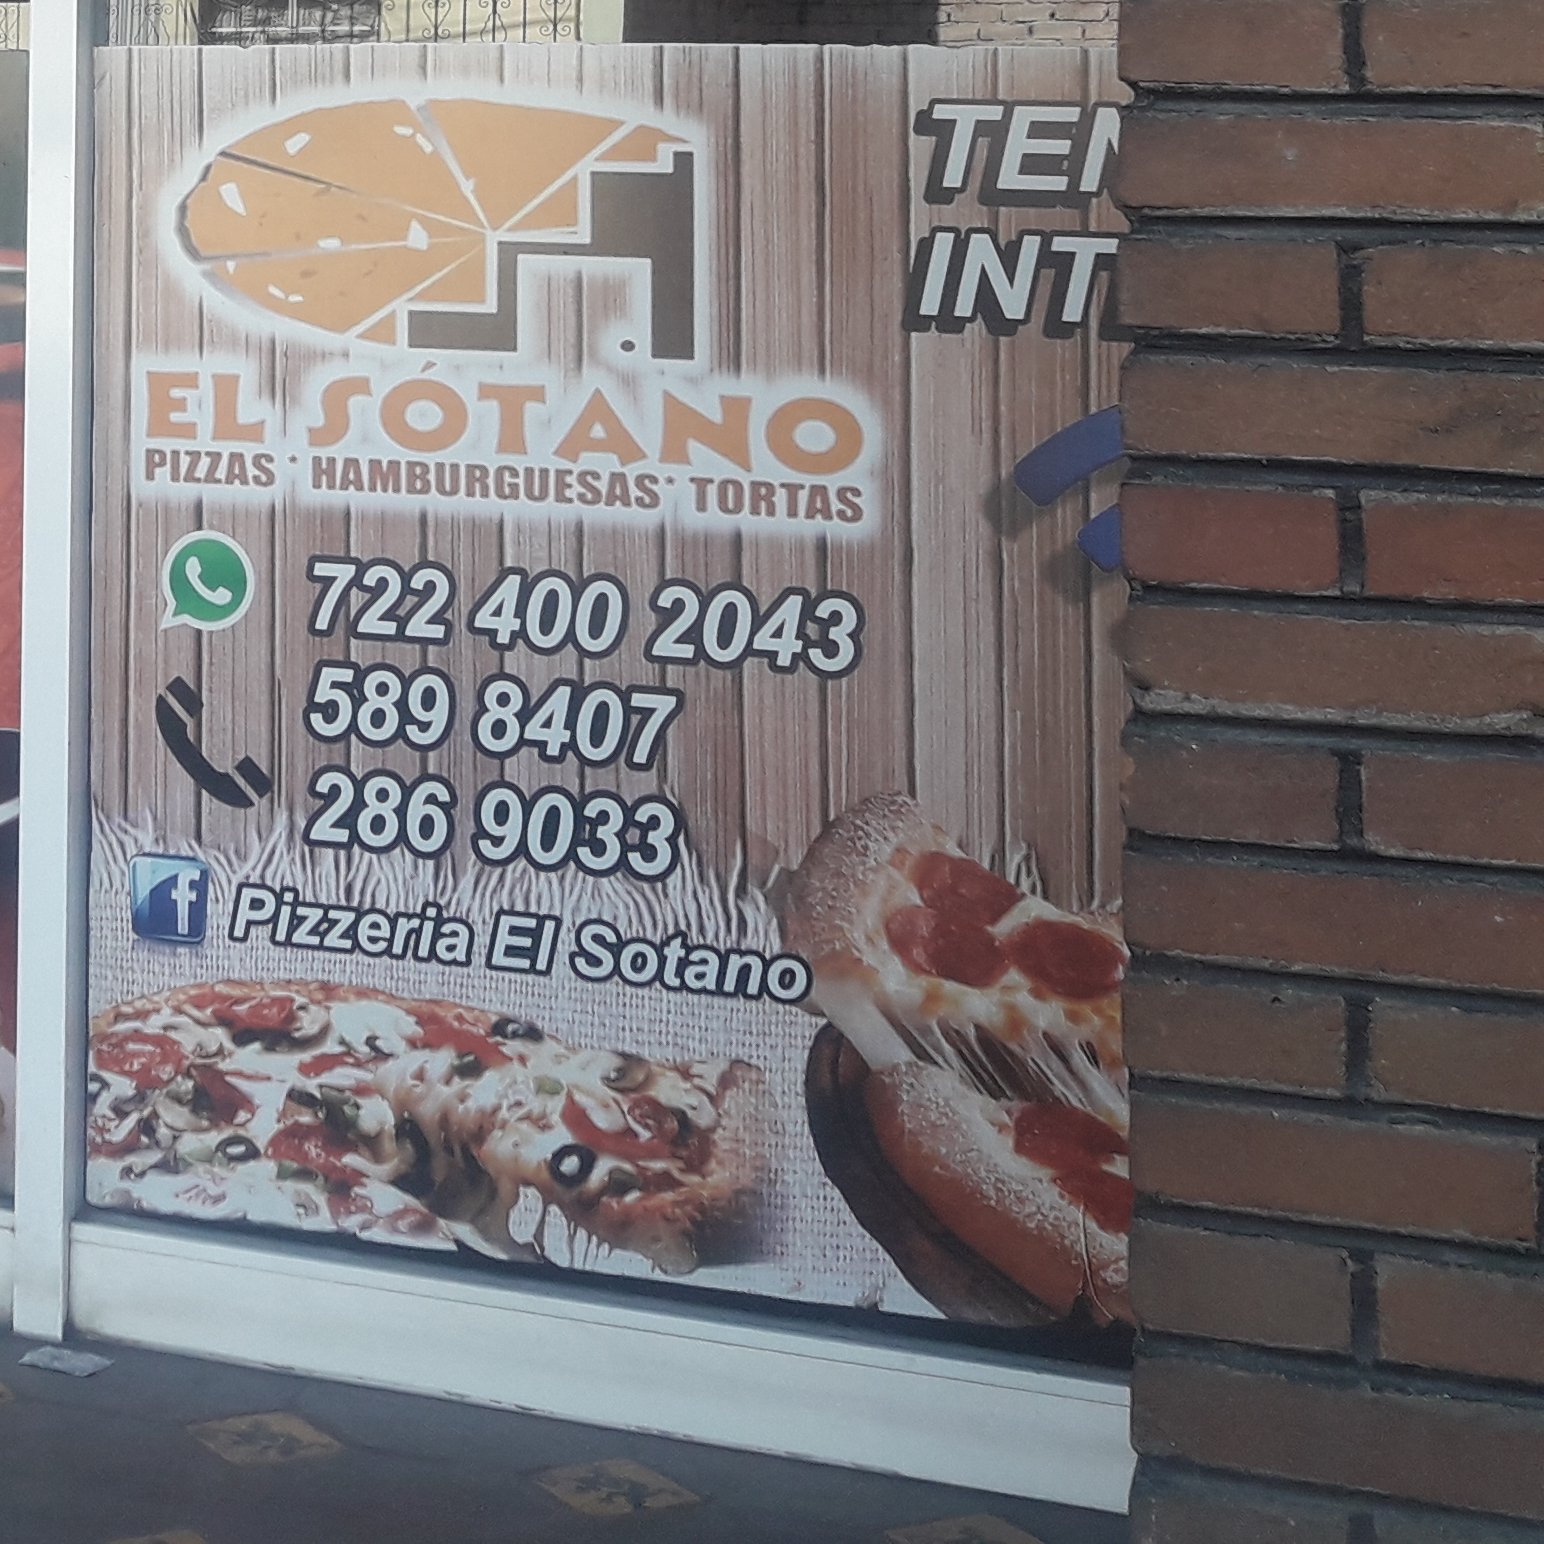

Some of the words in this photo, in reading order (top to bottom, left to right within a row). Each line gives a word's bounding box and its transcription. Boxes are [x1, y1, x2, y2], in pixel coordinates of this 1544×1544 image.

[145, 370, 266, 445] EL
[144, 447, 275, 487] PIZZAS
[311, 457, 659, 511] HAMBURGUESAS
[689, 476, 864, 524] TORTAS
[309, 562, 453, 639] 722
[473, 572, 625, 653] 400
[651, 585, 858, 673] 2043
[308, 666, 451, 746] 589
[476, 679, 679, 765] 8407
[308, 771, 451, 853] 286
[477, 786, 675, 877] 9033
[233, 886, 471, 964] Pizzeria
[489, 913, 557, 973] El
[573, 931, 809, 1001] Sotano
